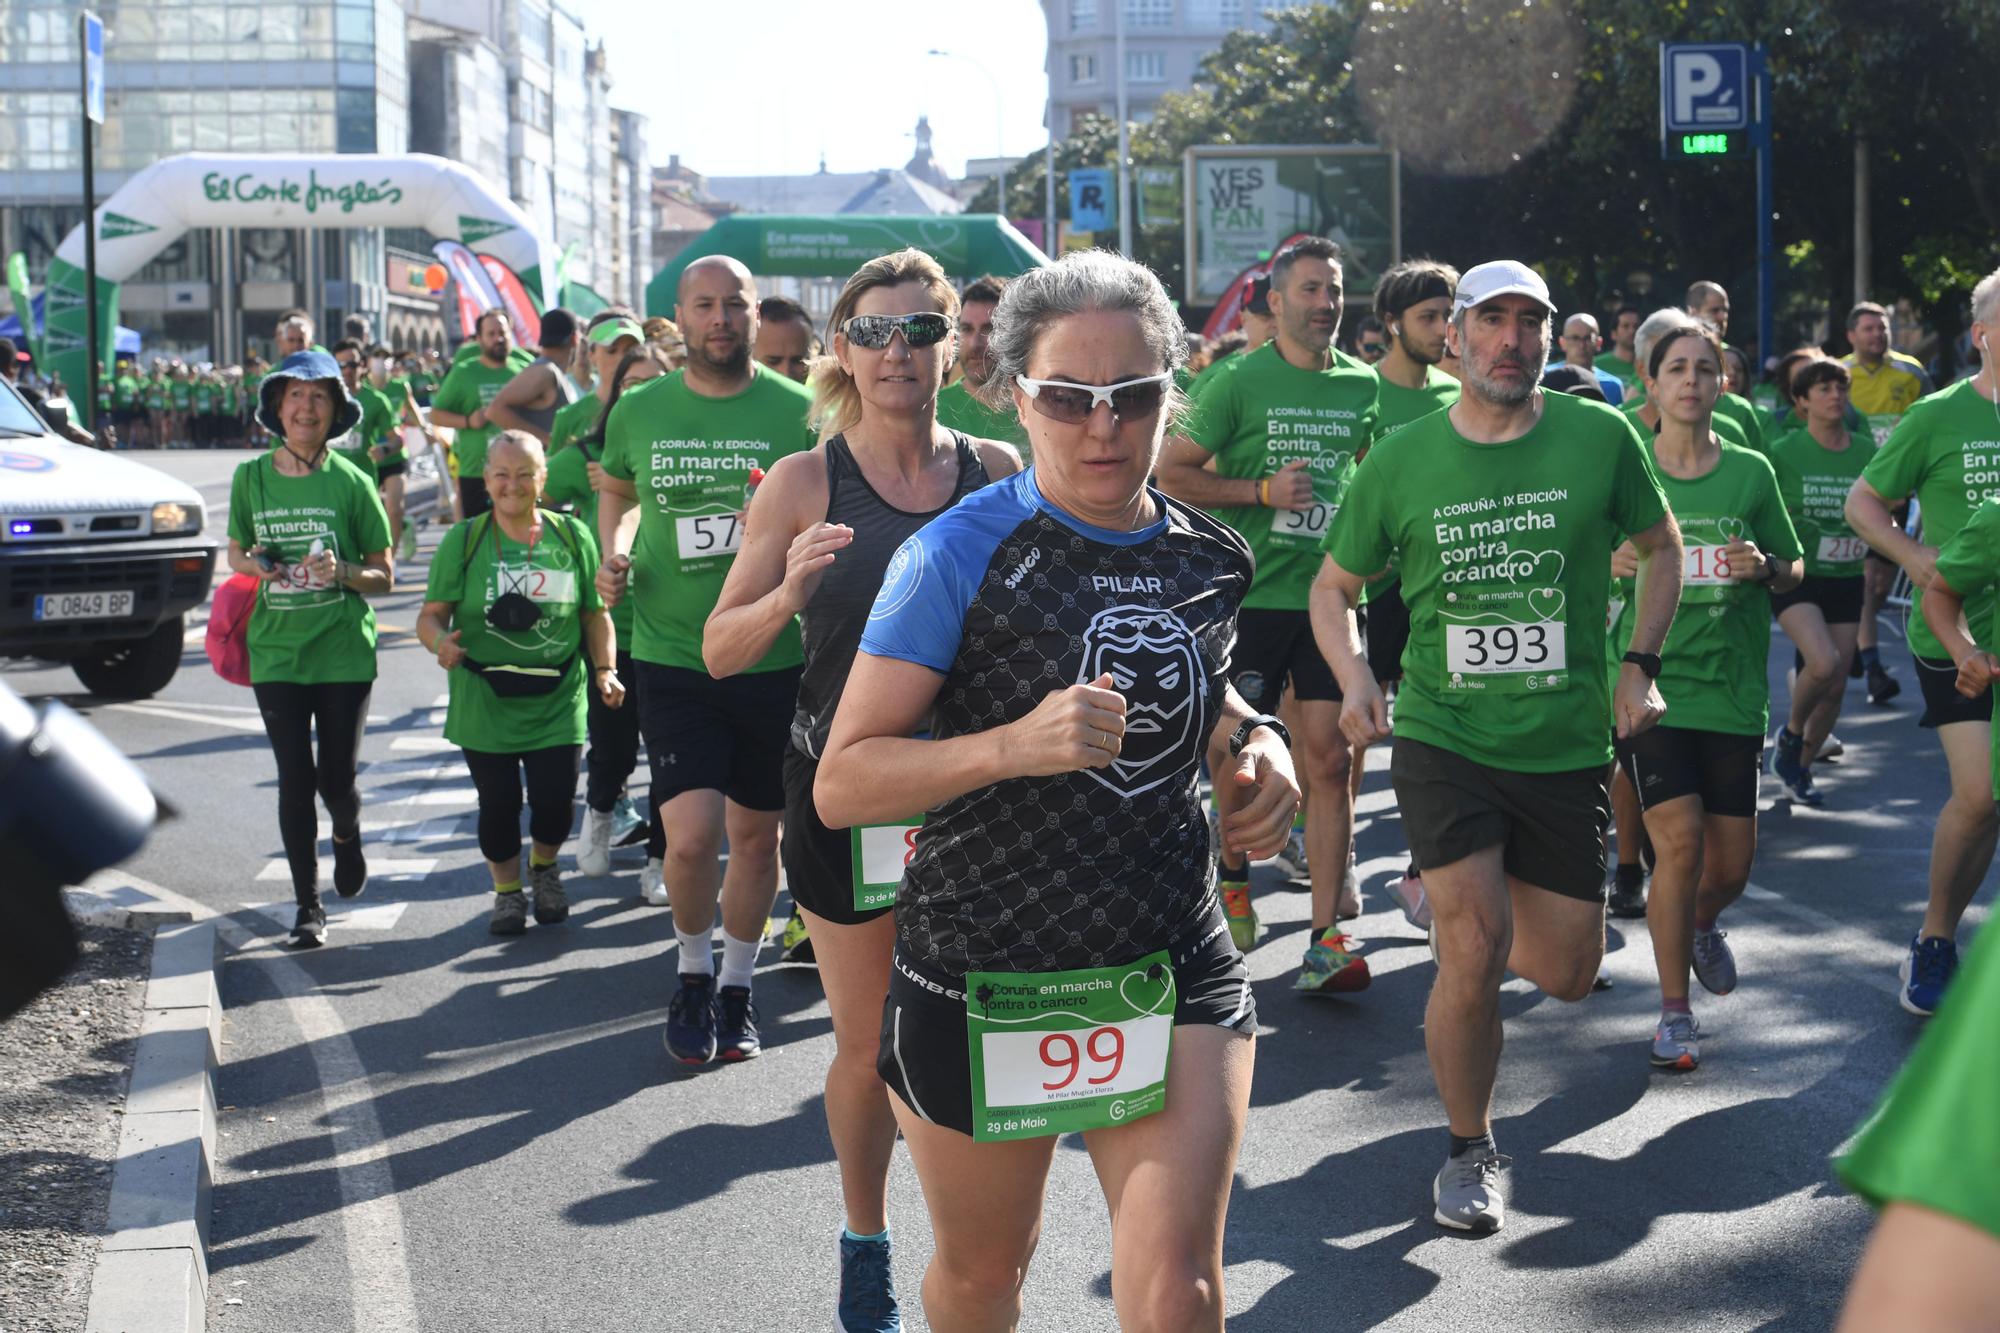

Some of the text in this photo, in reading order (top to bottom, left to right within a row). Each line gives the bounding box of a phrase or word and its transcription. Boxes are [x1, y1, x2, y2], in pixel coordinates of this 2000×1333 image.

[1674, 53, 1722, 122] P
[1683, 135, 1727, 154] LIBRE
[1210, 168, 1264, 189] YES
[203, 168, 402, 213] El Corte Inglés
[1211, 187, 1253, 209] WE
[1212, 208, 1264, 229] FAN
[1267, 420, 1351, 437] En marcha
[651, 439, 770, 450] A CORUÑA IX EDICIÓN
[1267, 438, 1320, 452] contra
[1962, 442, 1969, 450] A
[651, 454, 758, 470] En marcha
[1267, 456, 1277, 466] o
[1963, 453, 1987, 468] En
[651, 471, 715, 488] contra
[1803, 483, 1850, 495] En marc
[1966, 490, 1977, 501] o
[1433, 488, 1567, 519] A CORUÑA IX EDICIÓN
[1803, 497, 1841, 506] contra
[270, 519, 328, 534] marcha
[1435, 510, 1556, 544] En marcha
[1441, 541, 1508, 565] contra
[1092, 575, 1163, 594] PILAR
[1491, 590, 1524, 600] marcha
[45, 593, 130, 616] C 0849 BP
[1465, 625, 1548, 666] 393
[864, 895, 875, 903] 29
[877, 893, 887, 901] de
[1040, 986, 1057, 995] en
[1061, 979, 1112, 992] marcha
[1029, 1001, 1037, 1009] o
[1040, 996, 1087, 1009] cancro
[1039, 1027, 1125, 1090] 99
[987, 1116, 1047, 1133] 29 de Maio
